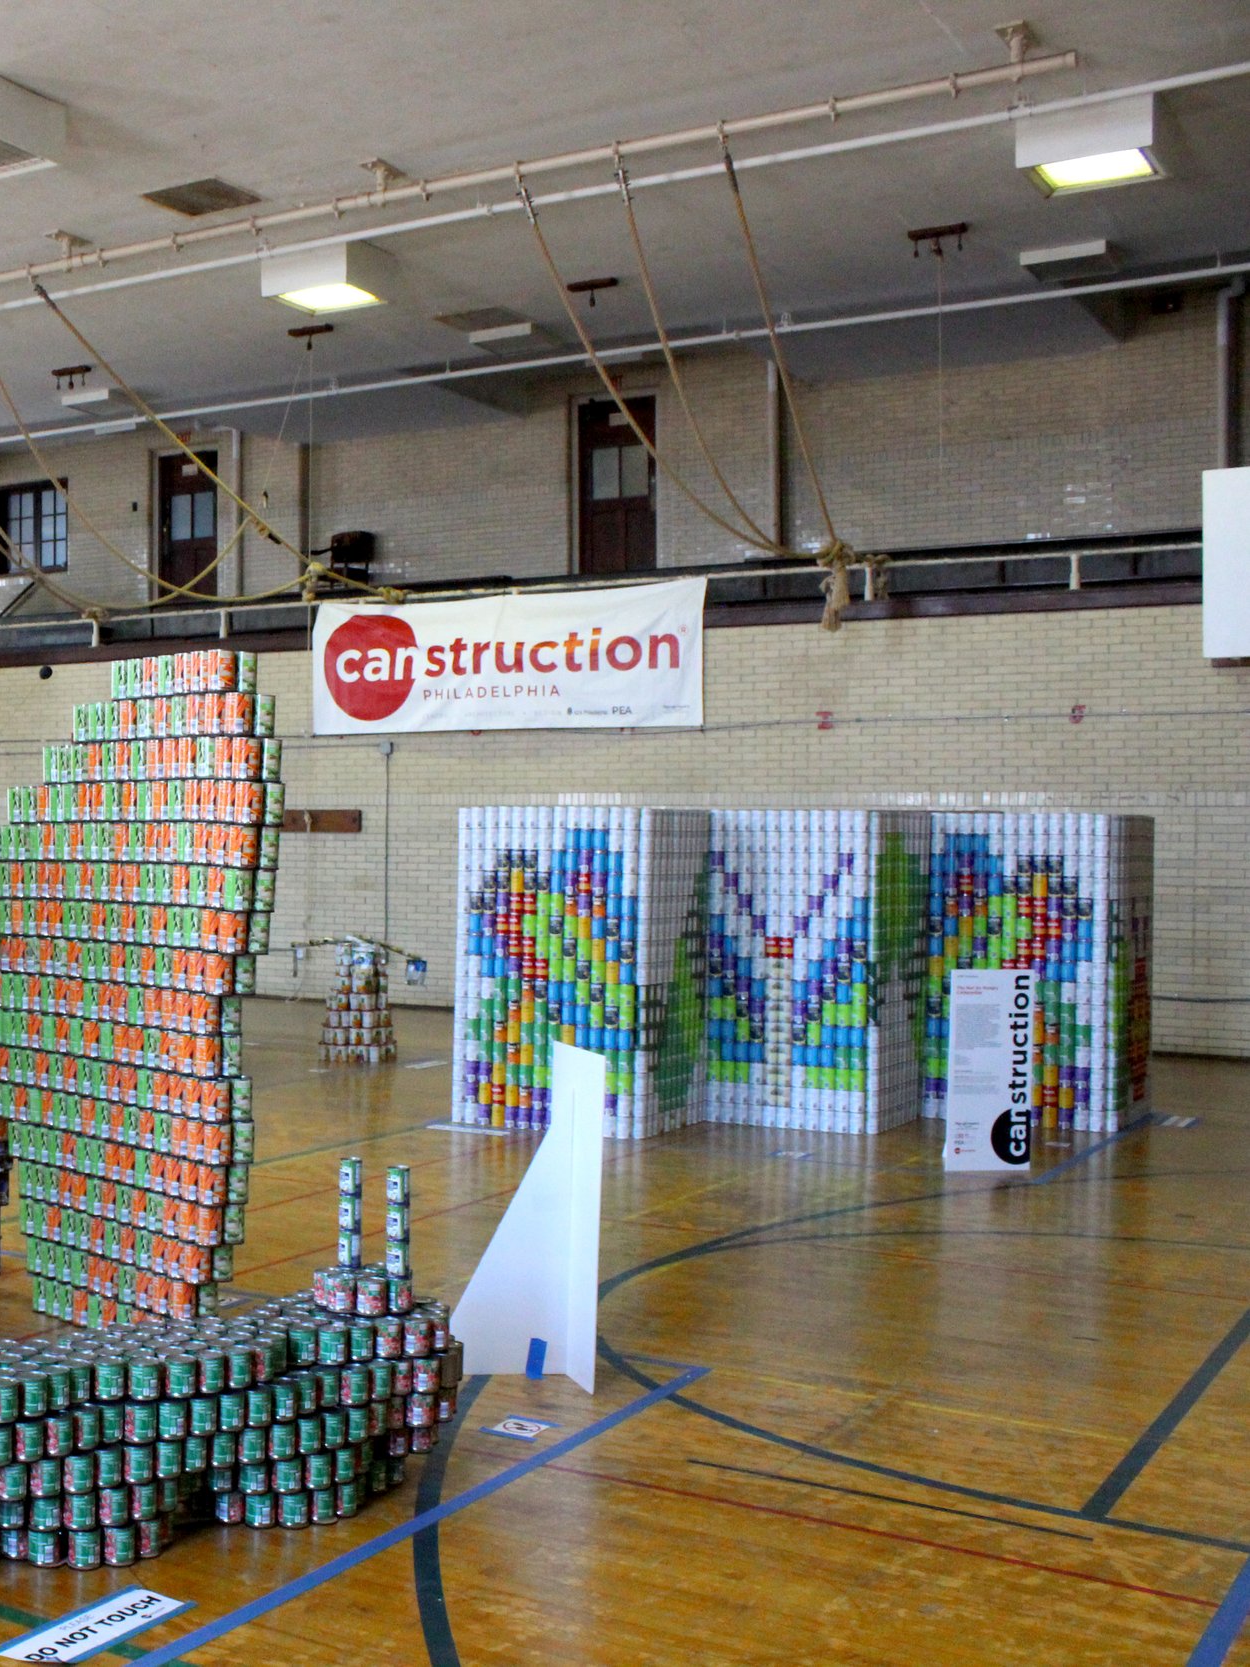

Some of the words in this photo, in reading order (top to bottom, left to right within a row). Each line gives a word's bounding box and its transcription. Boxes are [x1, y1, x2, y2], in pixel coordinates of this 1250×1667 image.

[335, 626, 681, 684] canstruction
[423, 685, 561, 701] PHILADELPHIA
[1008, 974, 1031, 1158] canstruction
[24, 1646, 59, 1662] DO
[54, 1625, 99, 1648] NOT
[94, 1595, 163, 1628] TOUCH
